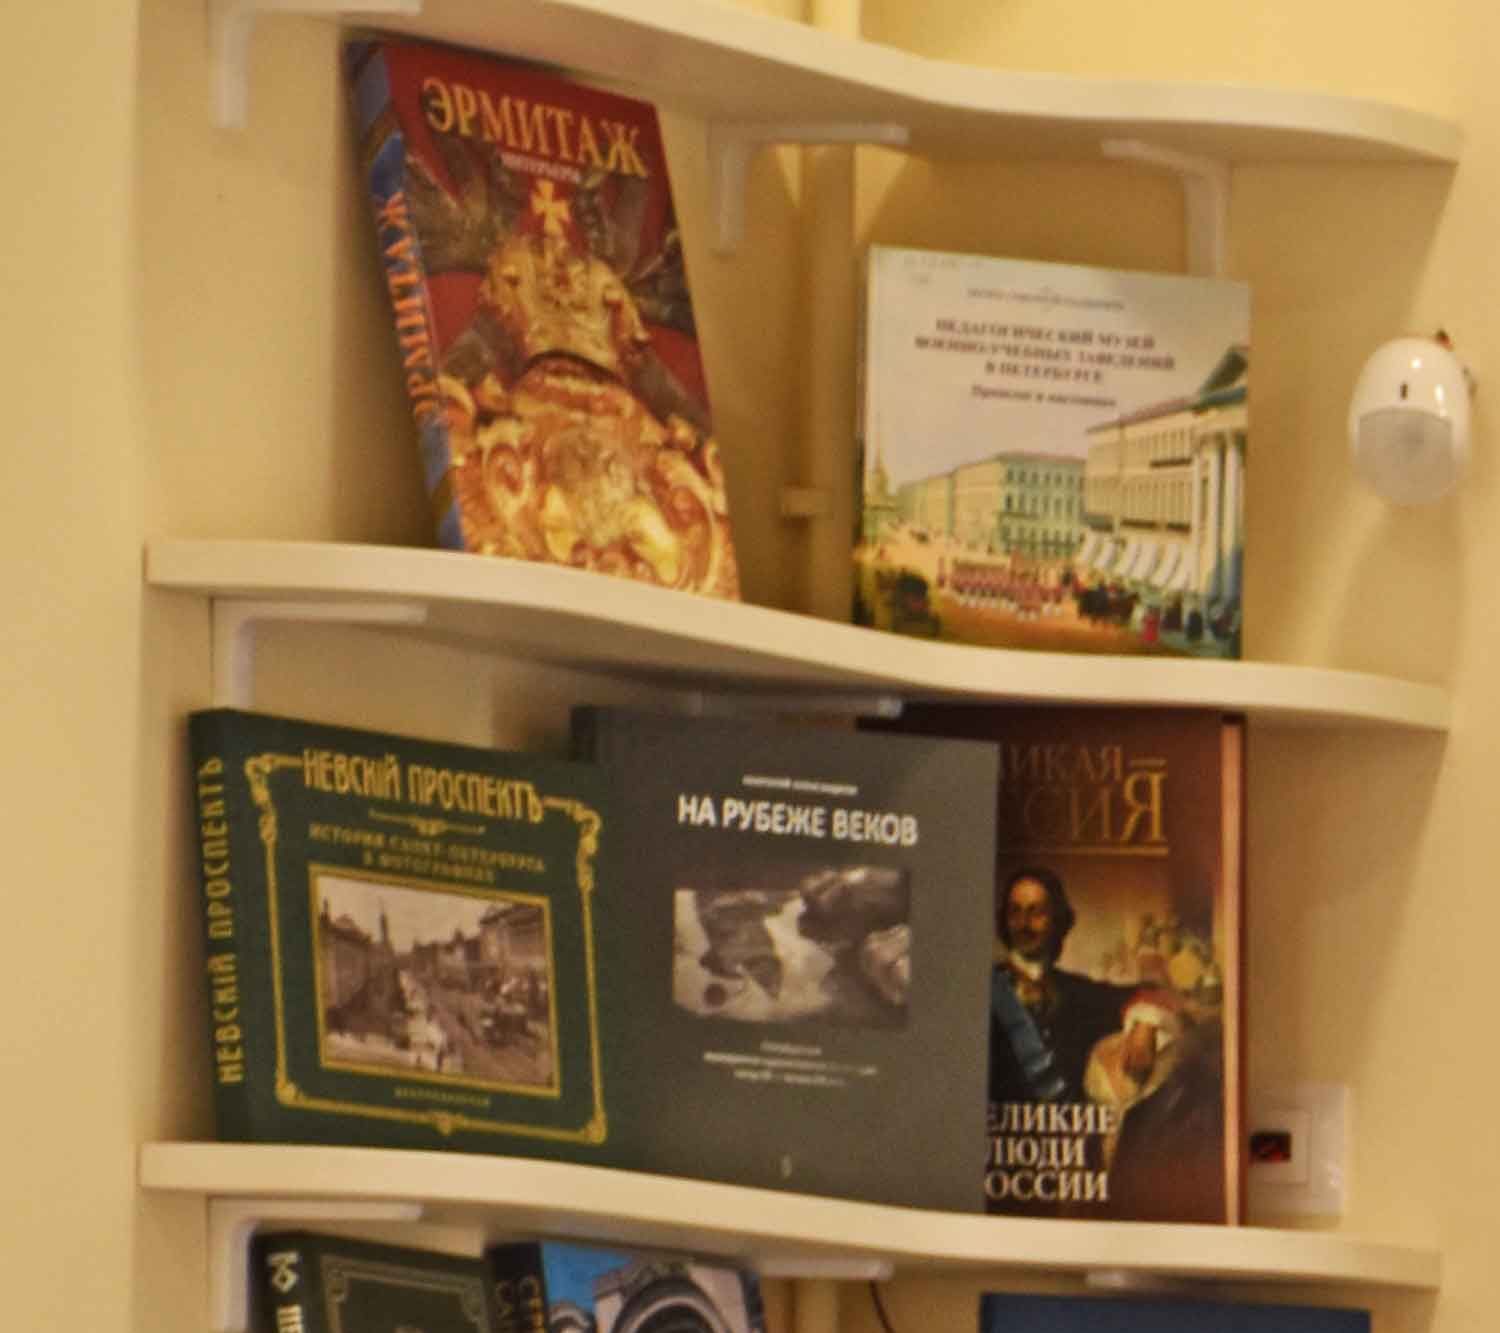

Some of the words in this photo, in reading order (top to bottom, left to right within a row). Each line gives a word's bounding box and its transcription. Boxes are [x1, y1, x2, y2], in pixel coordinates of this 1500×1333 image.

[423, 77, 648, 178] ЭРМИТАЖ
[1002, 742, 1123, 783] ИКАЯ
[408, 764, 545, 824] ПРОСПЕКТЪ
[677, 793, 717, 828] НА
[722, 796, 828, 840] РУБЕЖЕ
[832, 808, 919, 847] ВЕКОВ
[199, 755, 233, 940] ПРОСПЕКТЪ
